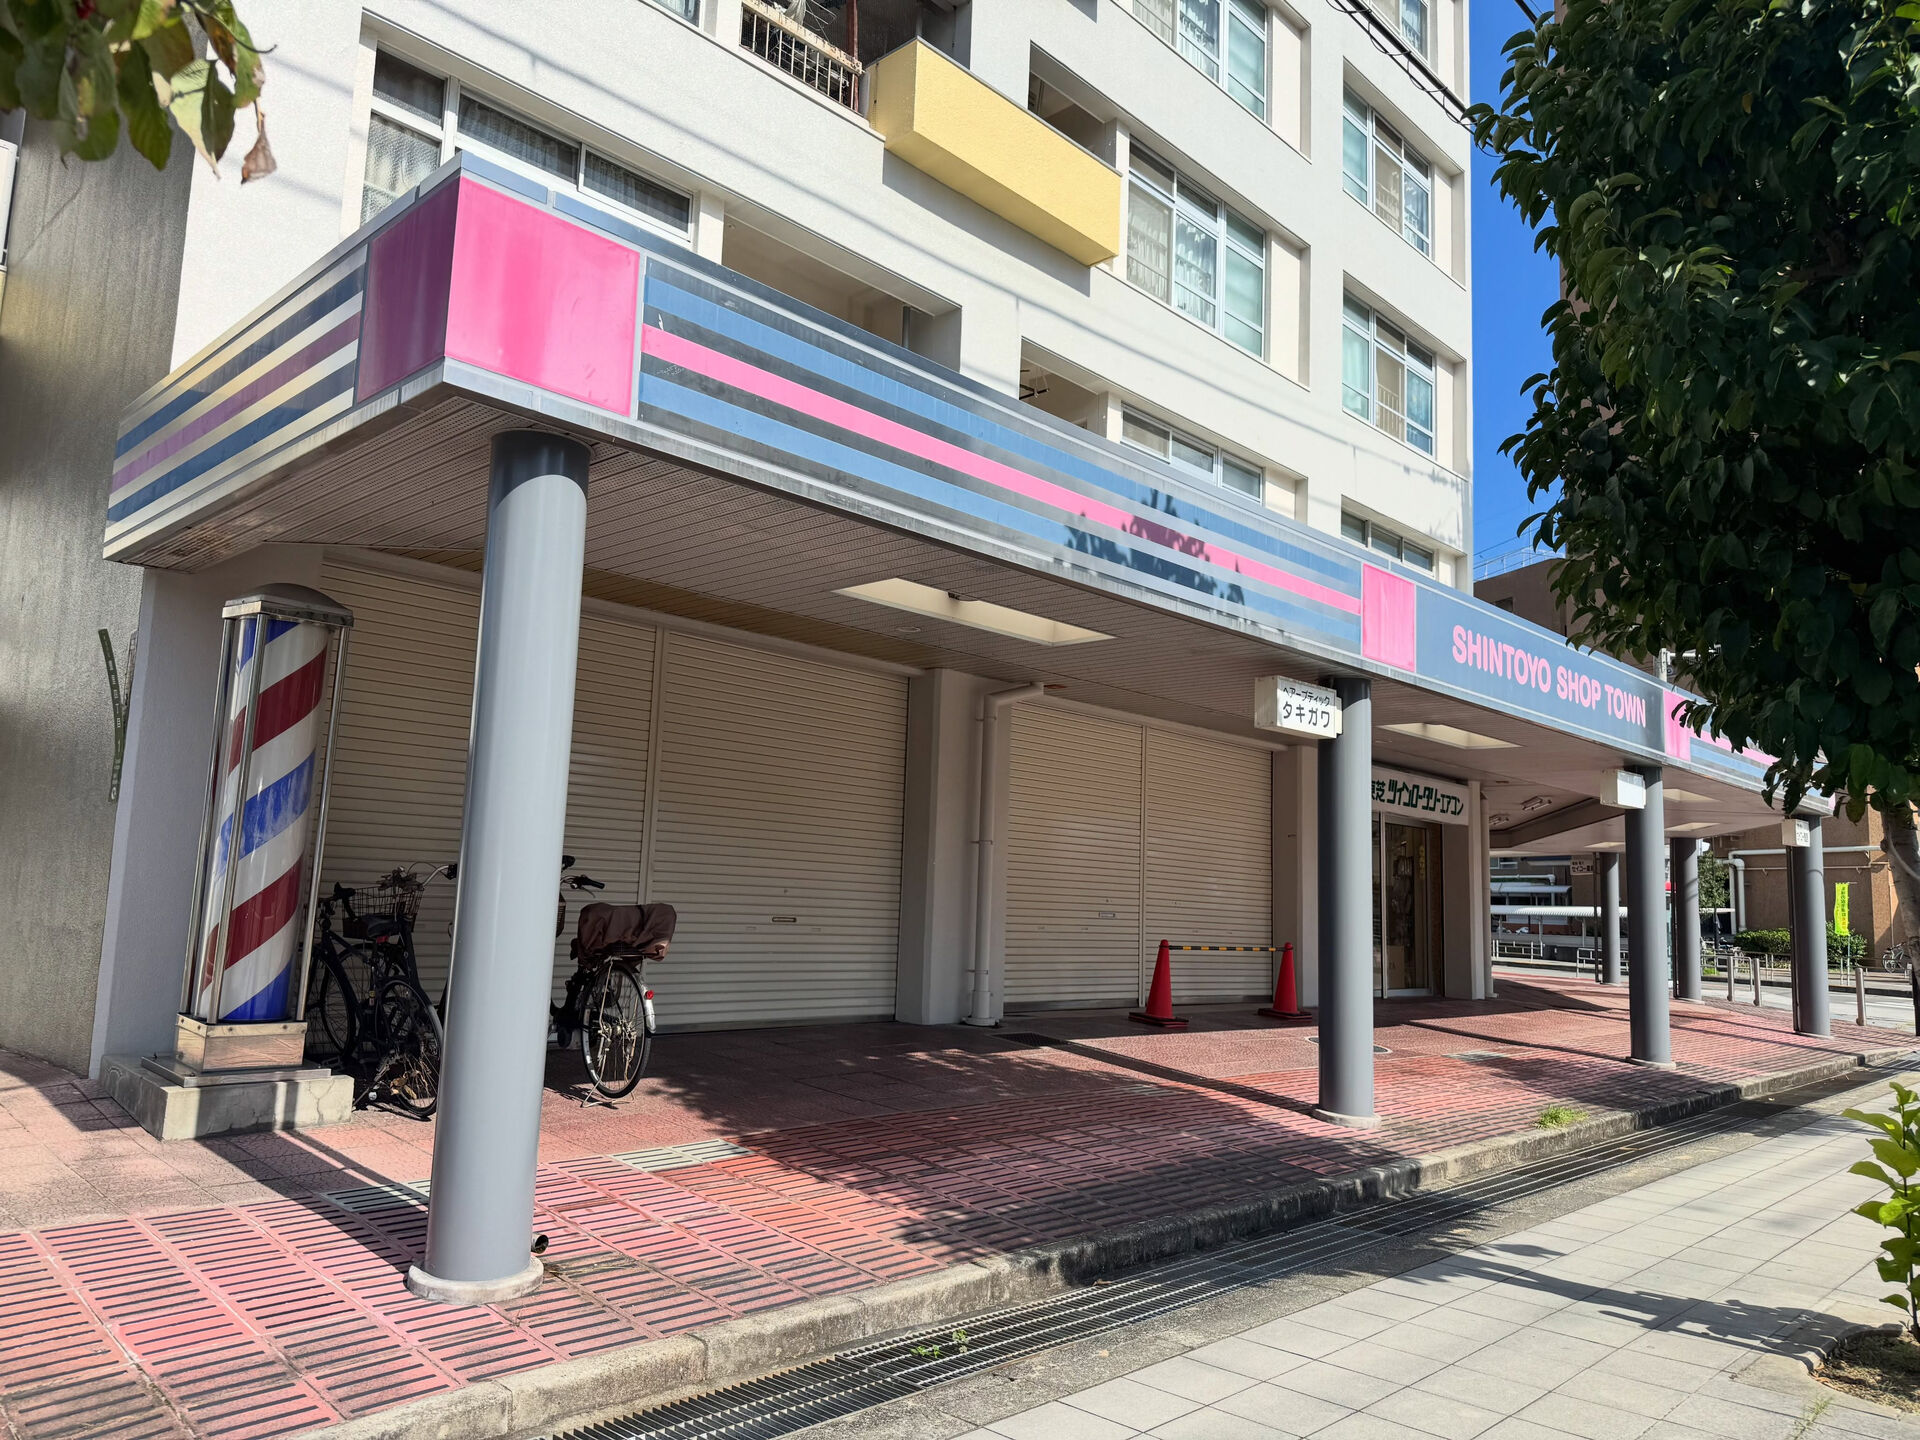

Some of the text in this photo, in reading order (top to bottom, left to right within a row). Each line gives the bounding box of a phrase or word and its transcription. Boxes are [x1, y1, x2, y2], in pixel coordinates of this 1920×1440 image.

[1452, 624, 1647, 729] SHINTOYO SHOP TOWN
[1282, 701, 1330, 728] タキガワ
